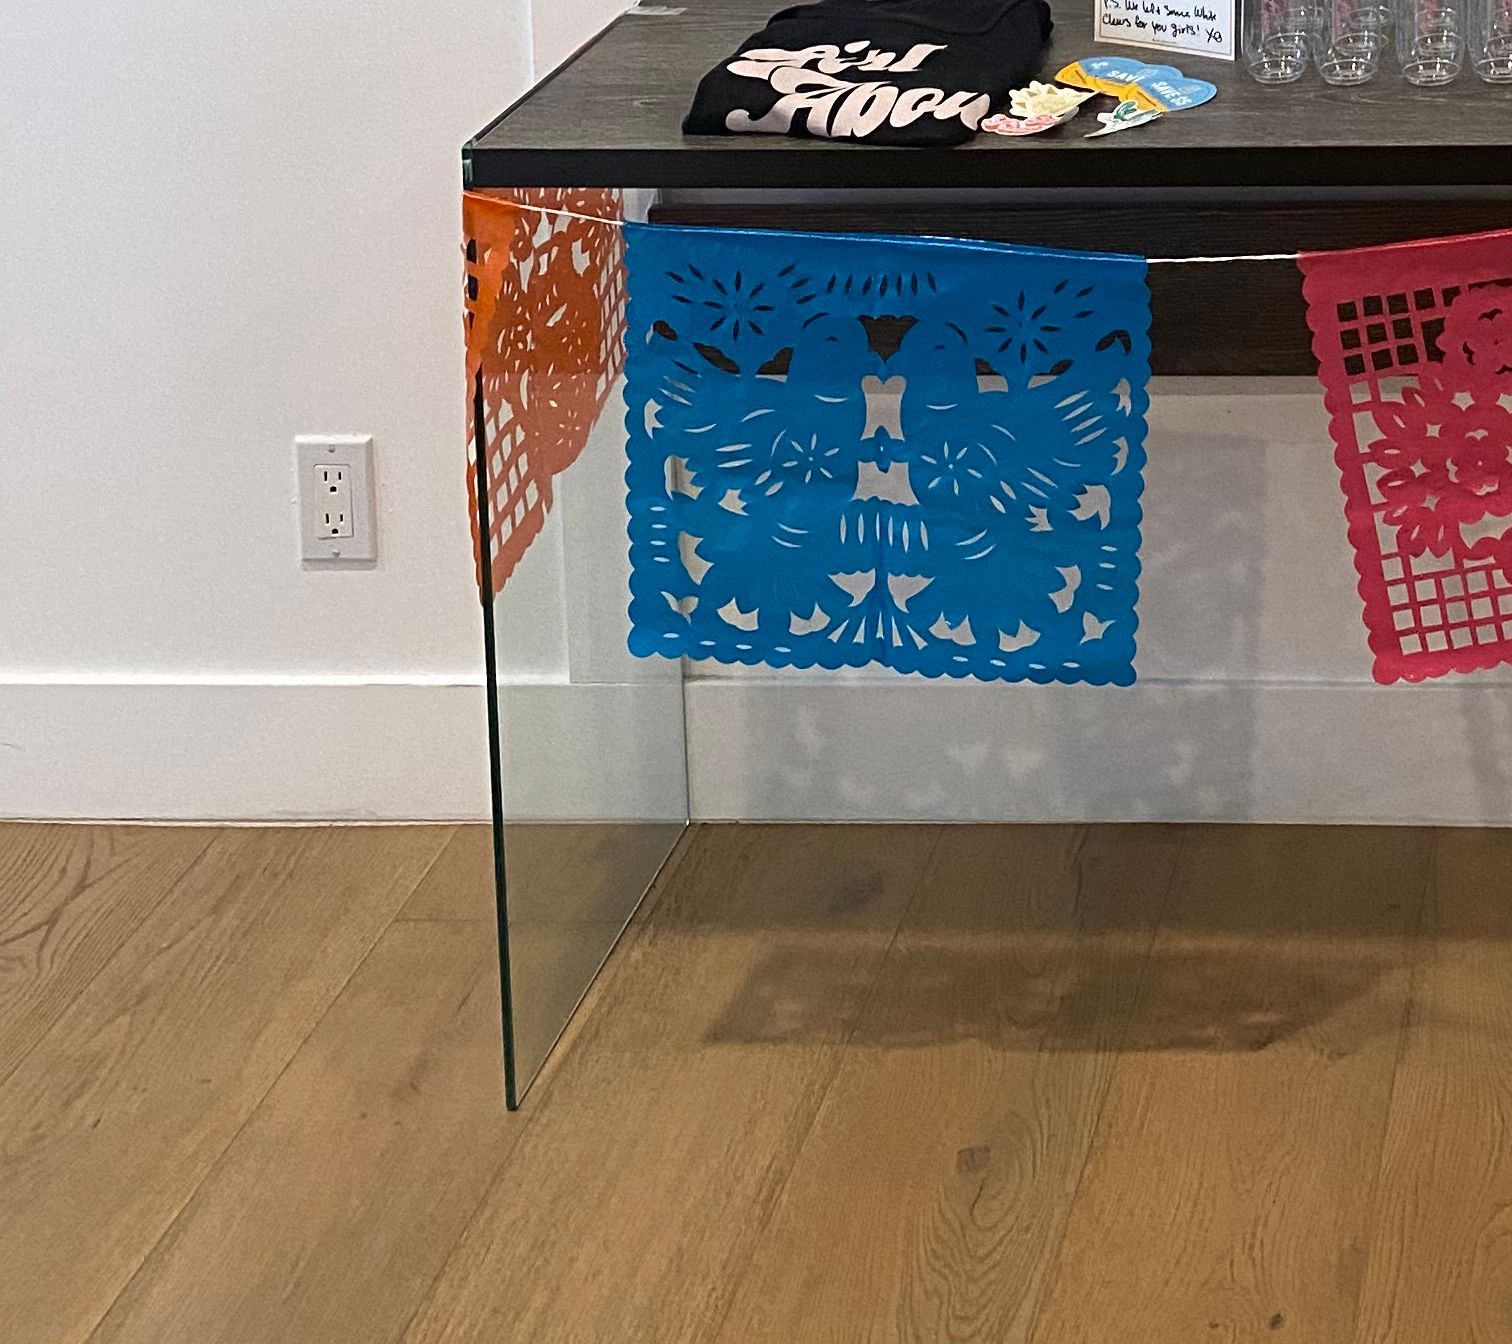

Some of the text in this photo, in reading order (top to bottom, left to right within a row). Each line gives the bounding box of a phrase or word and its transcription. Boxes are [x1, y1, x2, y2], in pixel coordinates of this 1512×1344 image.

[1142, 0, 1160, 15] left
[1135, 15, 1148, 29] for
[1152, 21, 1167, 35] you
